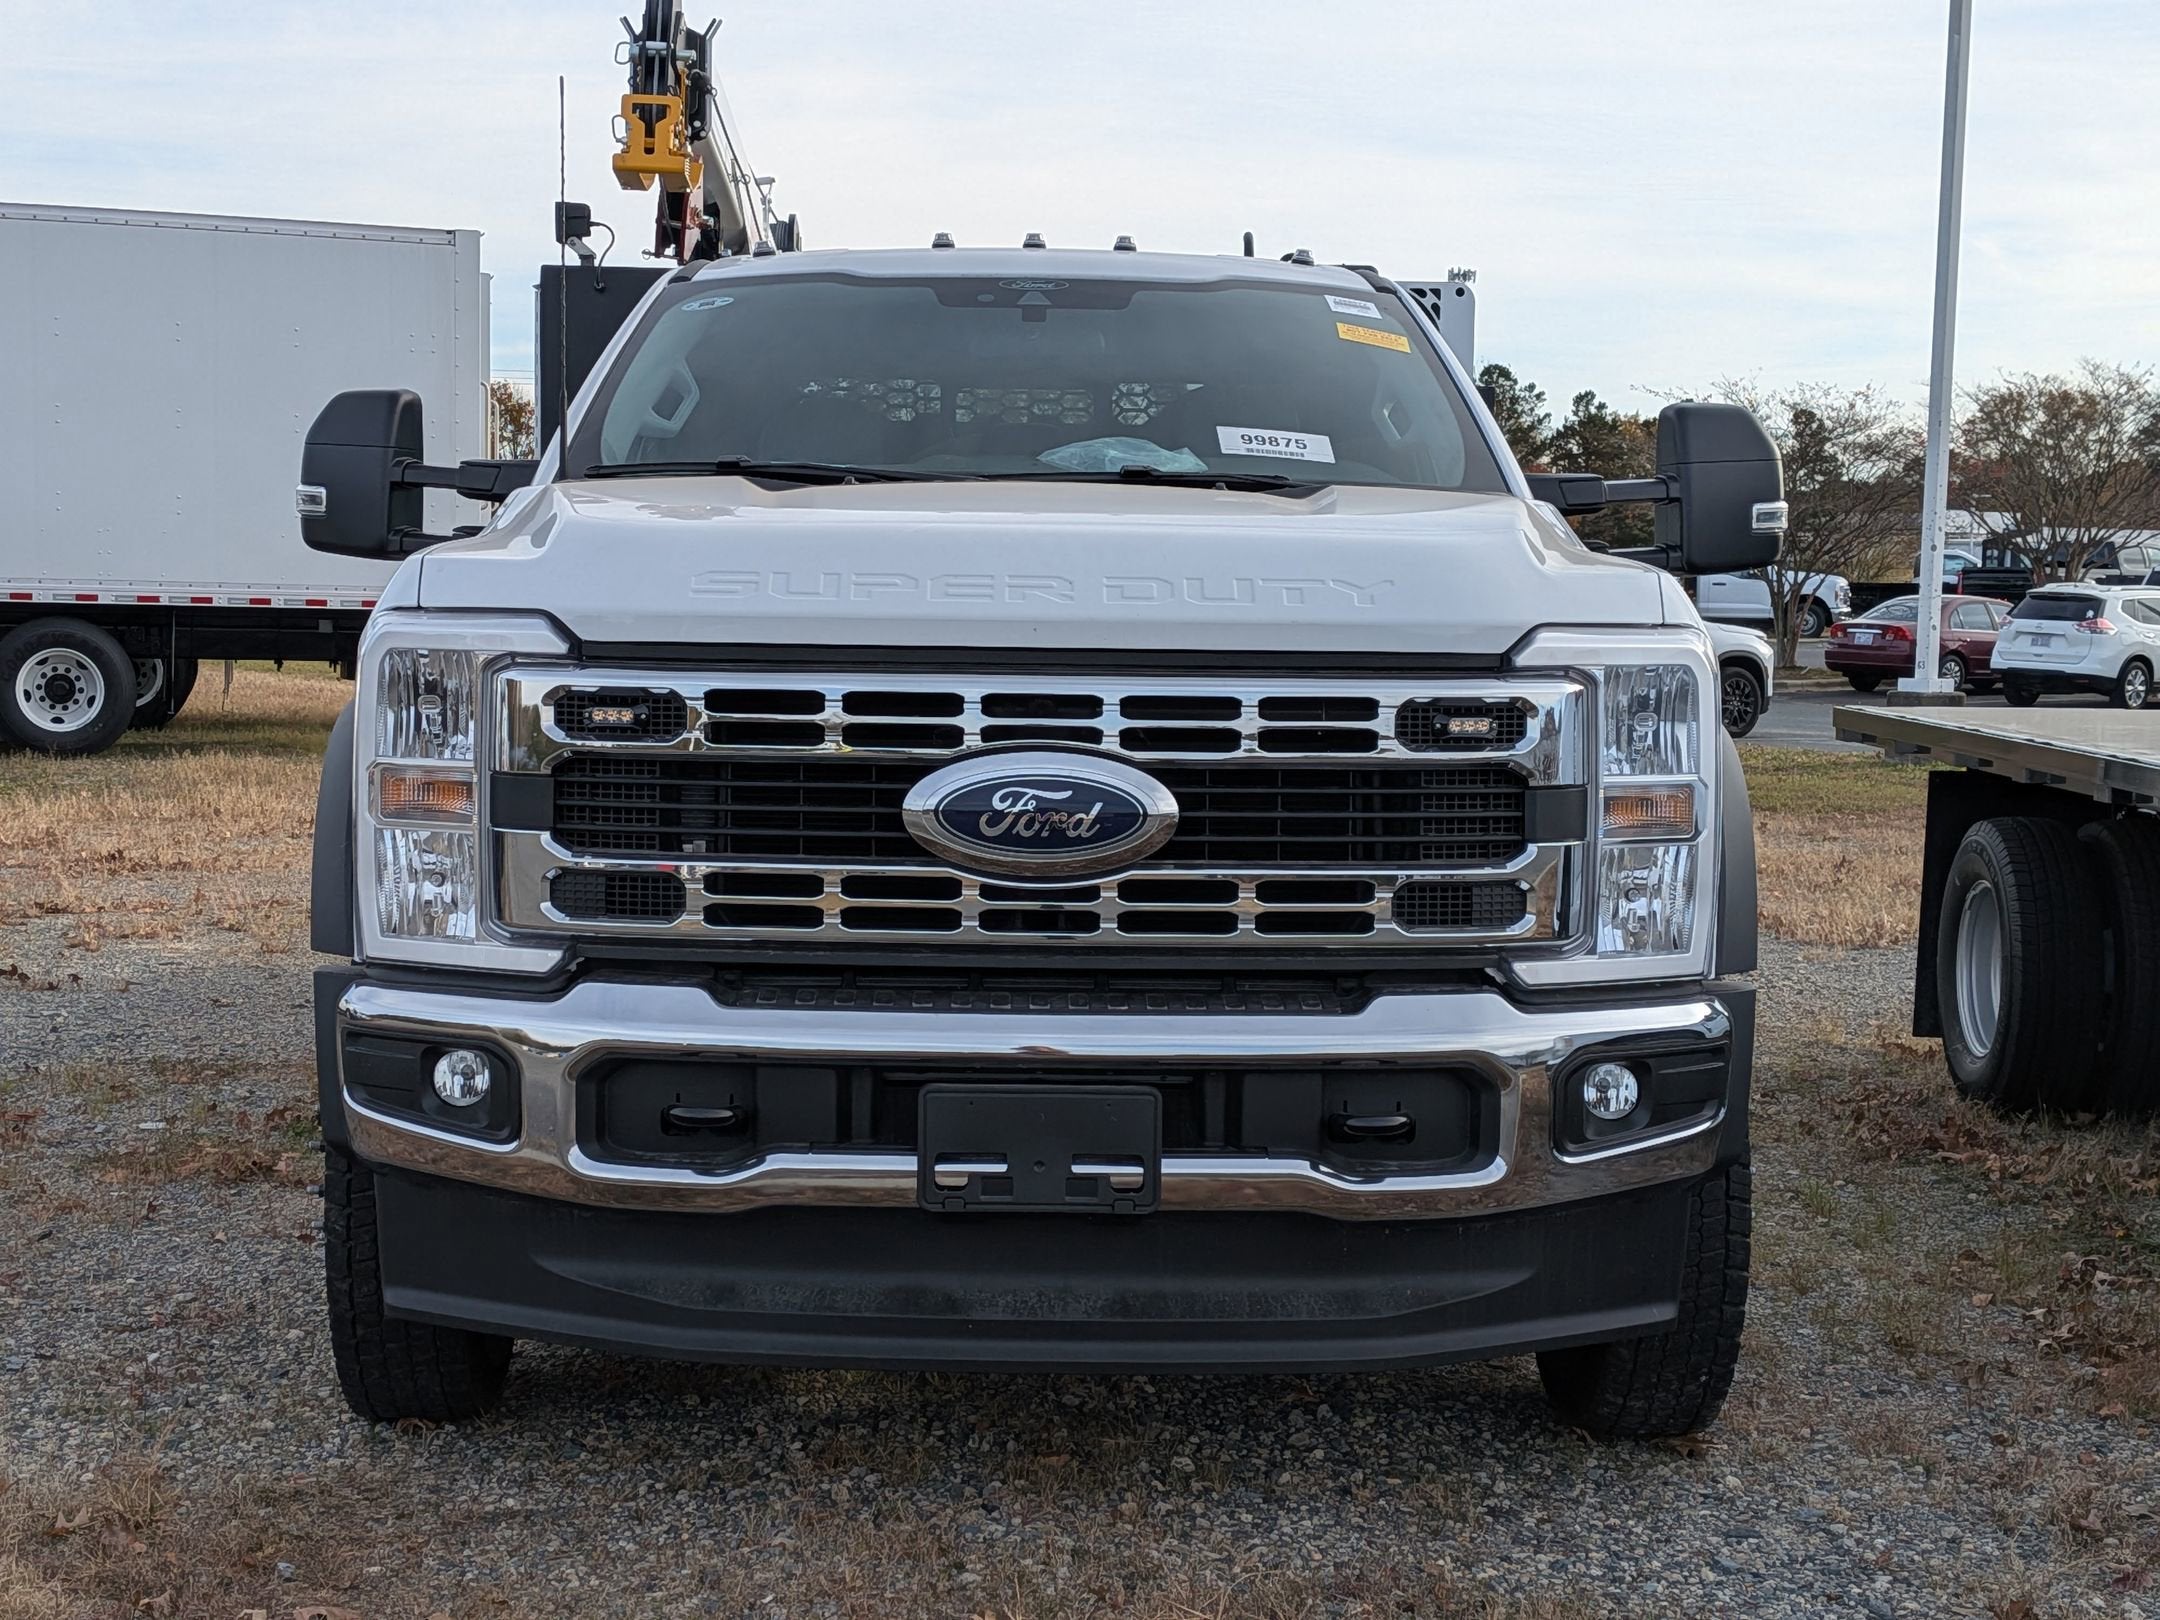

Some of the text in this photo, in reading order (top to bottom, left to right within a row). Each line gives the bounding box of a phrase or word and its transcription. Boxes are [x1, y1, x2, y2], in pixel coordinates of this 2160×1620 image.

[1240, 433, 1308, 450] 99875
[689, 570, 1394, 607] SUPER DUTY
[978, 786, 1104, 838] Ford
